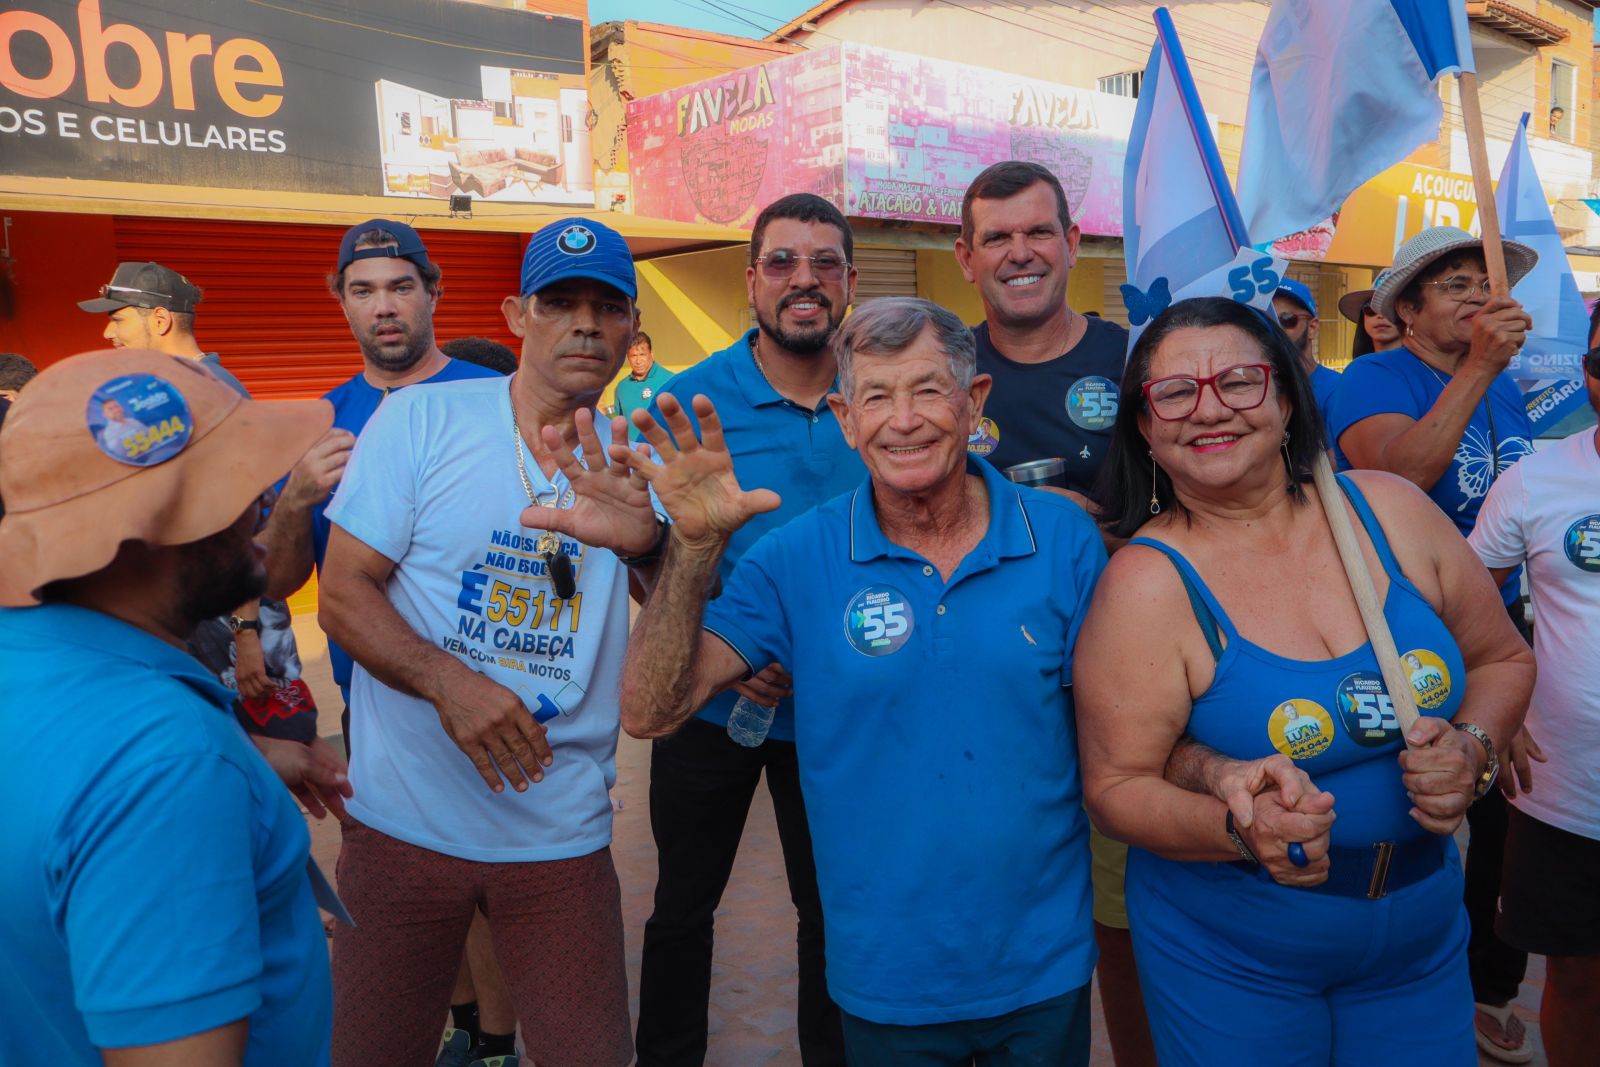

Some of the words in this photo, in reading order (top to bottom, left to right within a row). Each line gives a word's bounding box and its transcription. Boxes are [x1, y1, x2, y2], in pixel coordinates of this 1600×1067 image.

[0, 0, 284, 118] obre
[677, 64, 776, 137] FAVELA
[1008, 84, 1100, 130] FAVELA
[57, 111, 81, 138] E
[90, 115, 287, 153] CELULARES
[729, 112, 775, 135] MODAS
[859, 191, 923, 214] ATACADO
[926, 198, 938, 215] &
[941, 187, 967, 197] FEMININ
[1228, 256, 1280, 303] 55
[1081, 392, 1119, 417] 55
[123, 415, 186, 458] 55444
[490, 530, 521, 550] NÃO
[485, 551, 516, 571] NÃO
[457, 562, 490, 616] É
[486, 579, 583, 634] 55111
[457, 615, 487, 644] NA
[493, 627, 575, 662] CABEÇA
[863, 602, 908, 641] 55
[442, 636, 468, 656] VEM
[469, 648, 497, 665] COM
[528, 662, 571, 681] MOTOS
[1413, 671, 1442, 694] LUAN
[1353, 693, 1401, 730] 55
[1285, 722, 1321, 745] LUAN
[1291, 736, 1329, 756] 44.044
